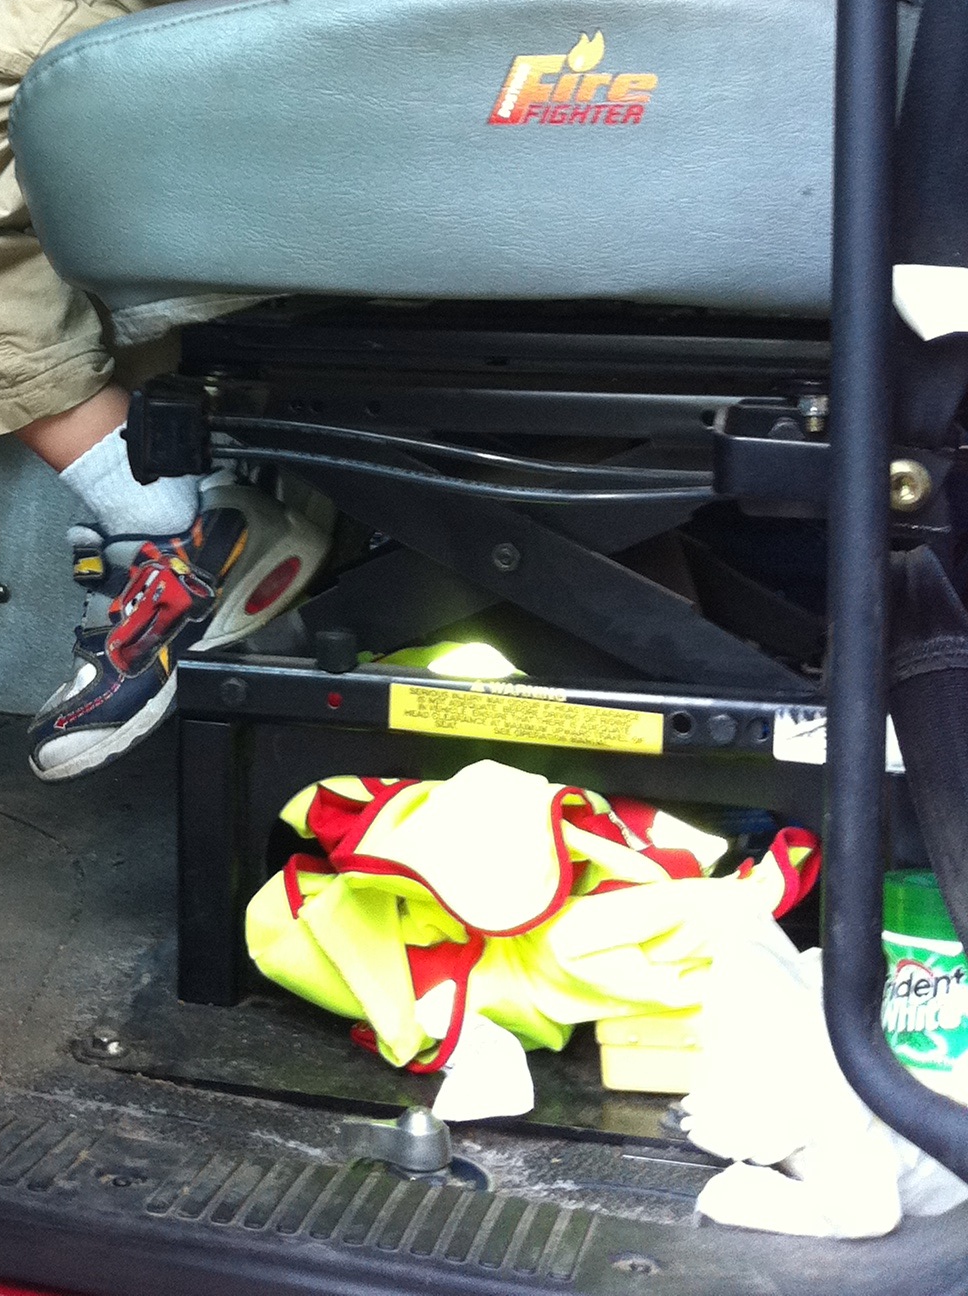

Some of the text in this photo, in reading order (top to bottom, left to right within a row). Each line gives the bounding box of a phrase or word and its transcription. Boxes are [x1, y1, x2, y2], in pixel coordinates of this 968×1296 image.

[488, 50, 659, 126] Fire
[523, 104, 646, 126] FIGHTER
[489, 681, 567, 702] WARNING
[882, 967, 966, 1001] rident
